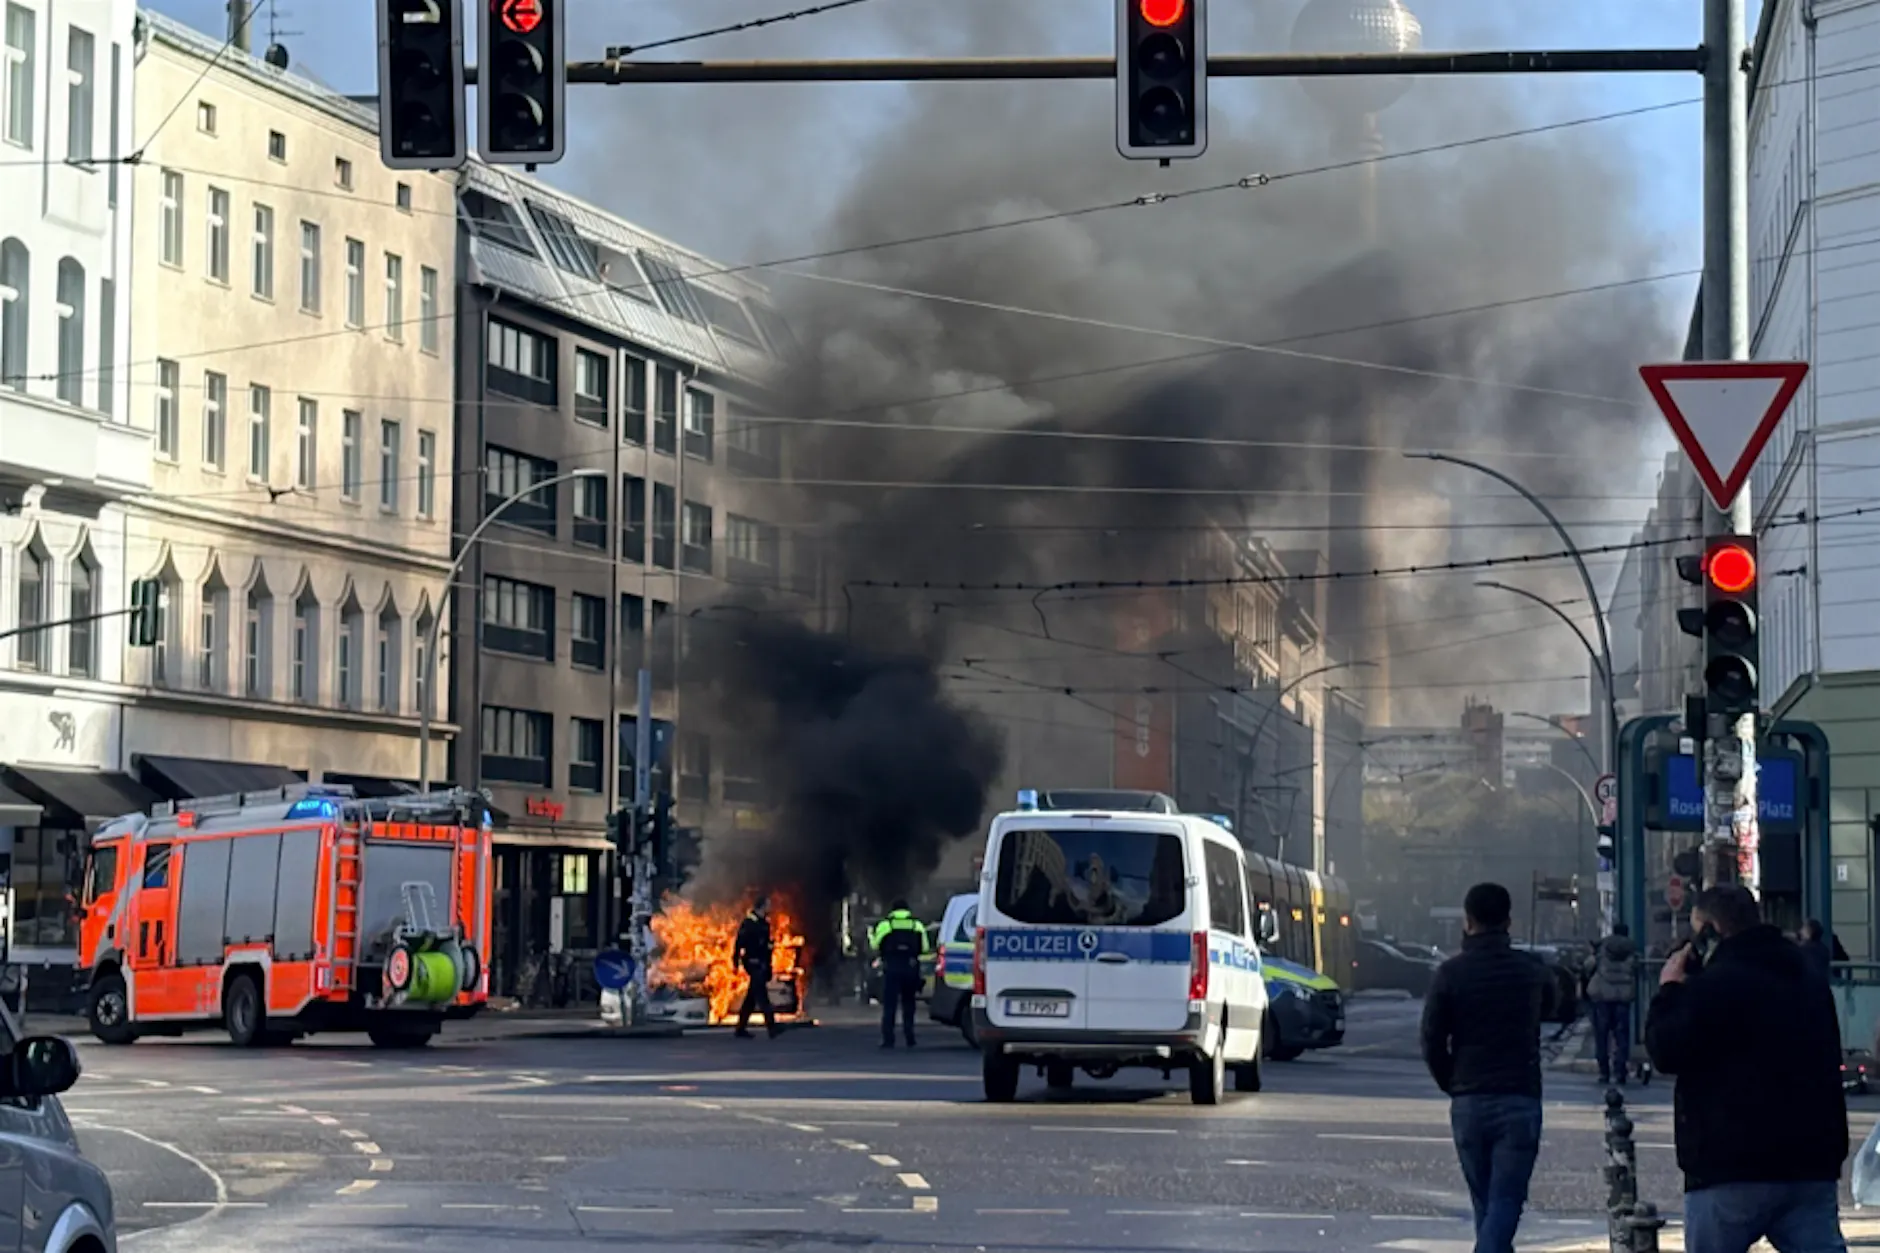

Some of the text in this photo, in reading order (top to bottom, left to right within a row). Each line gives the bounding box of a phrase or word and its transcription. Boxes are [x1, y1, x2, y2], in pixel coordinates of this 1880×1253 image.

[1670, 798, 1793, 818] Rose Platz
[992, 933, 1072, 954] POLIZEI
